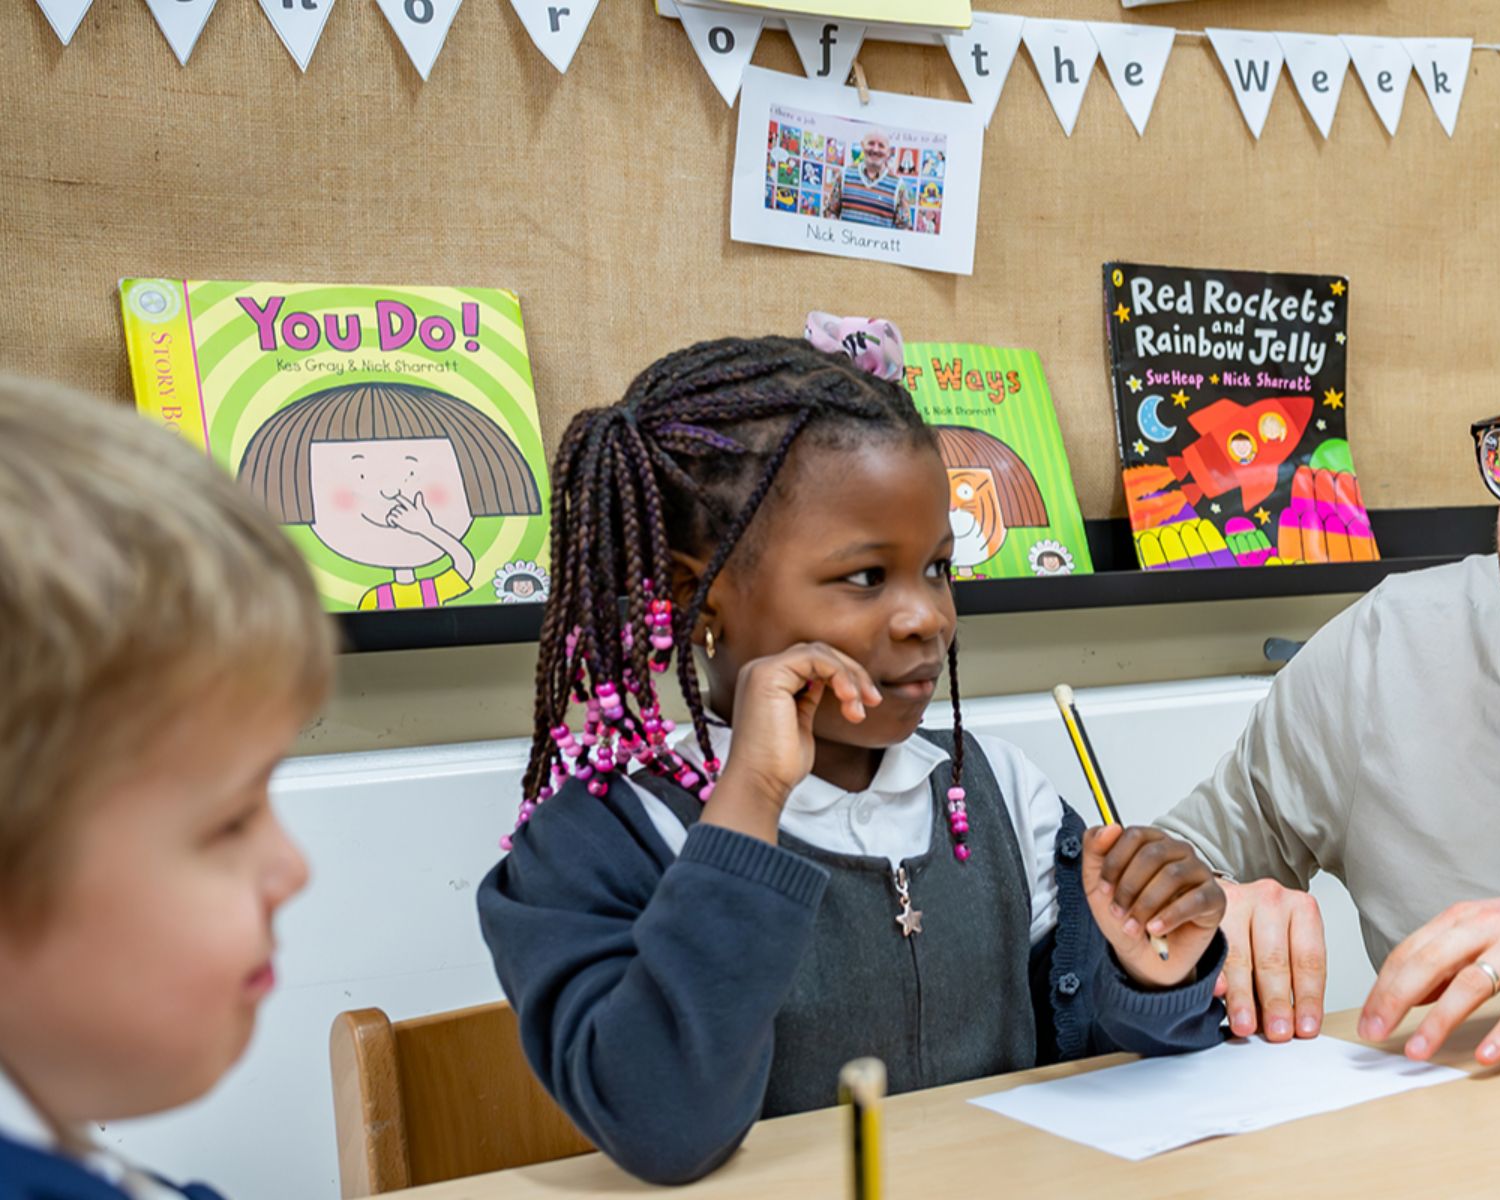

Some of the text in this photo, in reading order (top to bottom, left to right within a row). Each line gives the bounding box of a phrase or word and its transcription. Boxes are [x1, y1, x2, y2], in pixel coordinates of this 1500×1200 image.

[708, 25, 838, 77] of
[970, 43, 1145, 87] the
[1234, 56, 1453, 96] Week
[806, 223, 901, 253] Nick Sharratt
[1130, 276, 1336, 326] Red Rockets
[235, 296, 481, 353] You Do!
[1211, 317, 1246, 336] and
[276, 358, 459, 375] Kes Gray & Nick Sharratt
[1135, 323, 1327, 376] Rainbow Jelly
[931, 357, 1022, 405] Ways
[1146, 368, 1312, 392] Sue Heap Nick Sharratt
[933, 406, 952, 416] Nick
